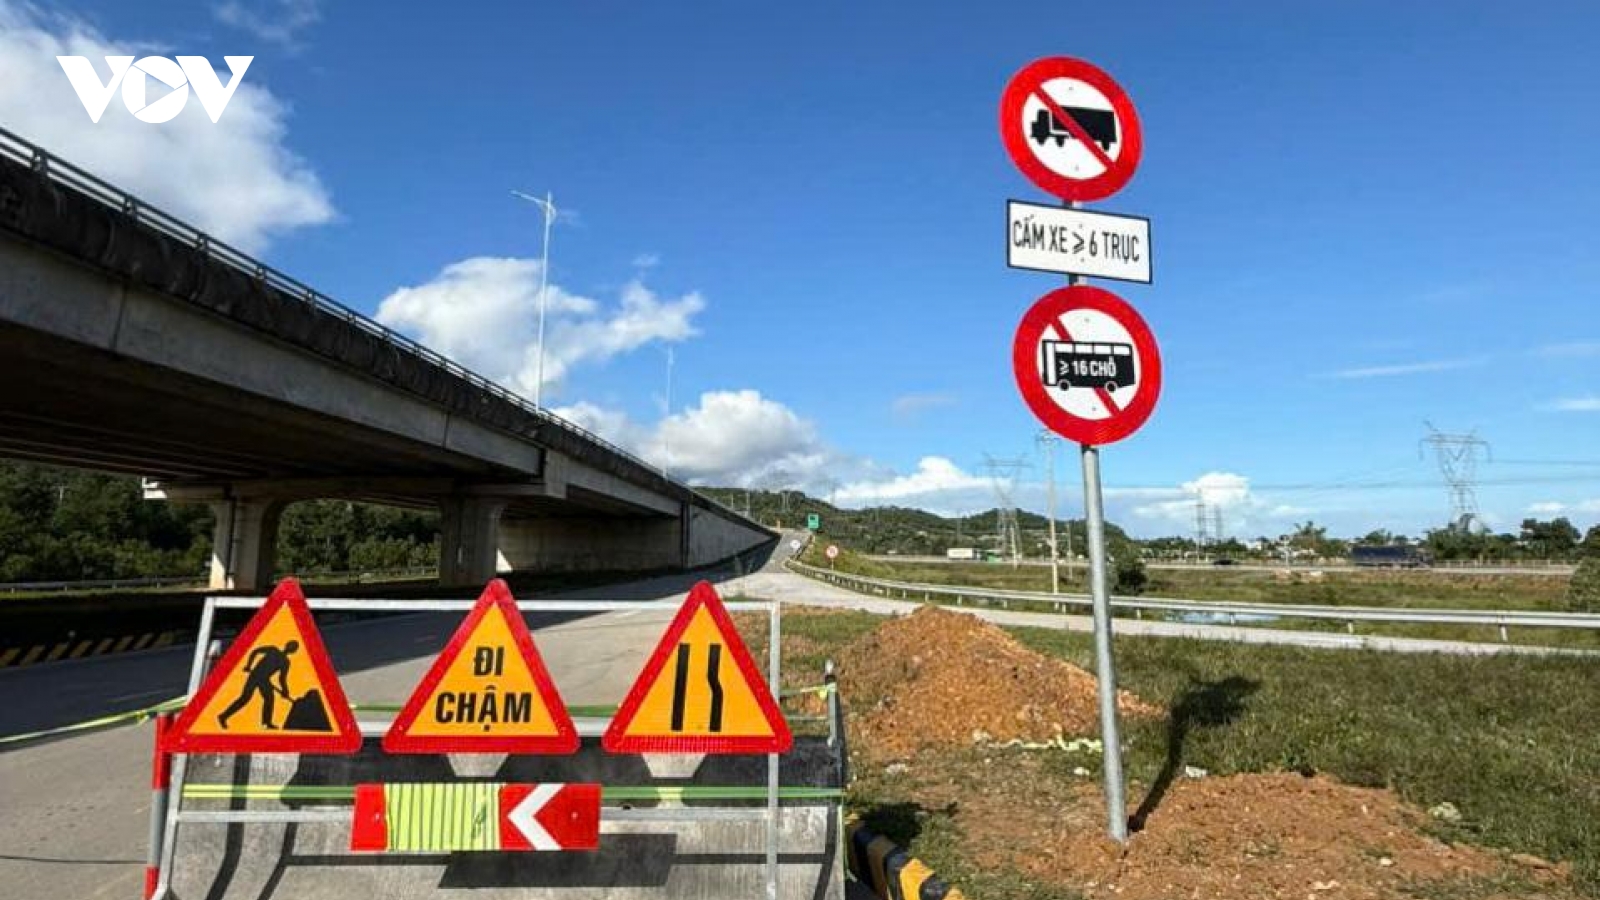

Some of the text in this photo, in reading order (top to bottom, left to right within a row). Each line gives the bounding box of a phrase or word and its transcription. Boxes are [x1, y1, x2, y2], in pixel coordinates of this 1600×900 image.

[1013, 214, 1045, 251] CẤM
[1049, 224, 1068, 253] XE
[1089, 230, 1098, 257] 6
[1102, 231, 1140, 264] TRỤC
[1072, 360, 1088, 376] 16
[473, 646, 504, 676] ĐI
[435, 684, 532, 732] CHẬM
